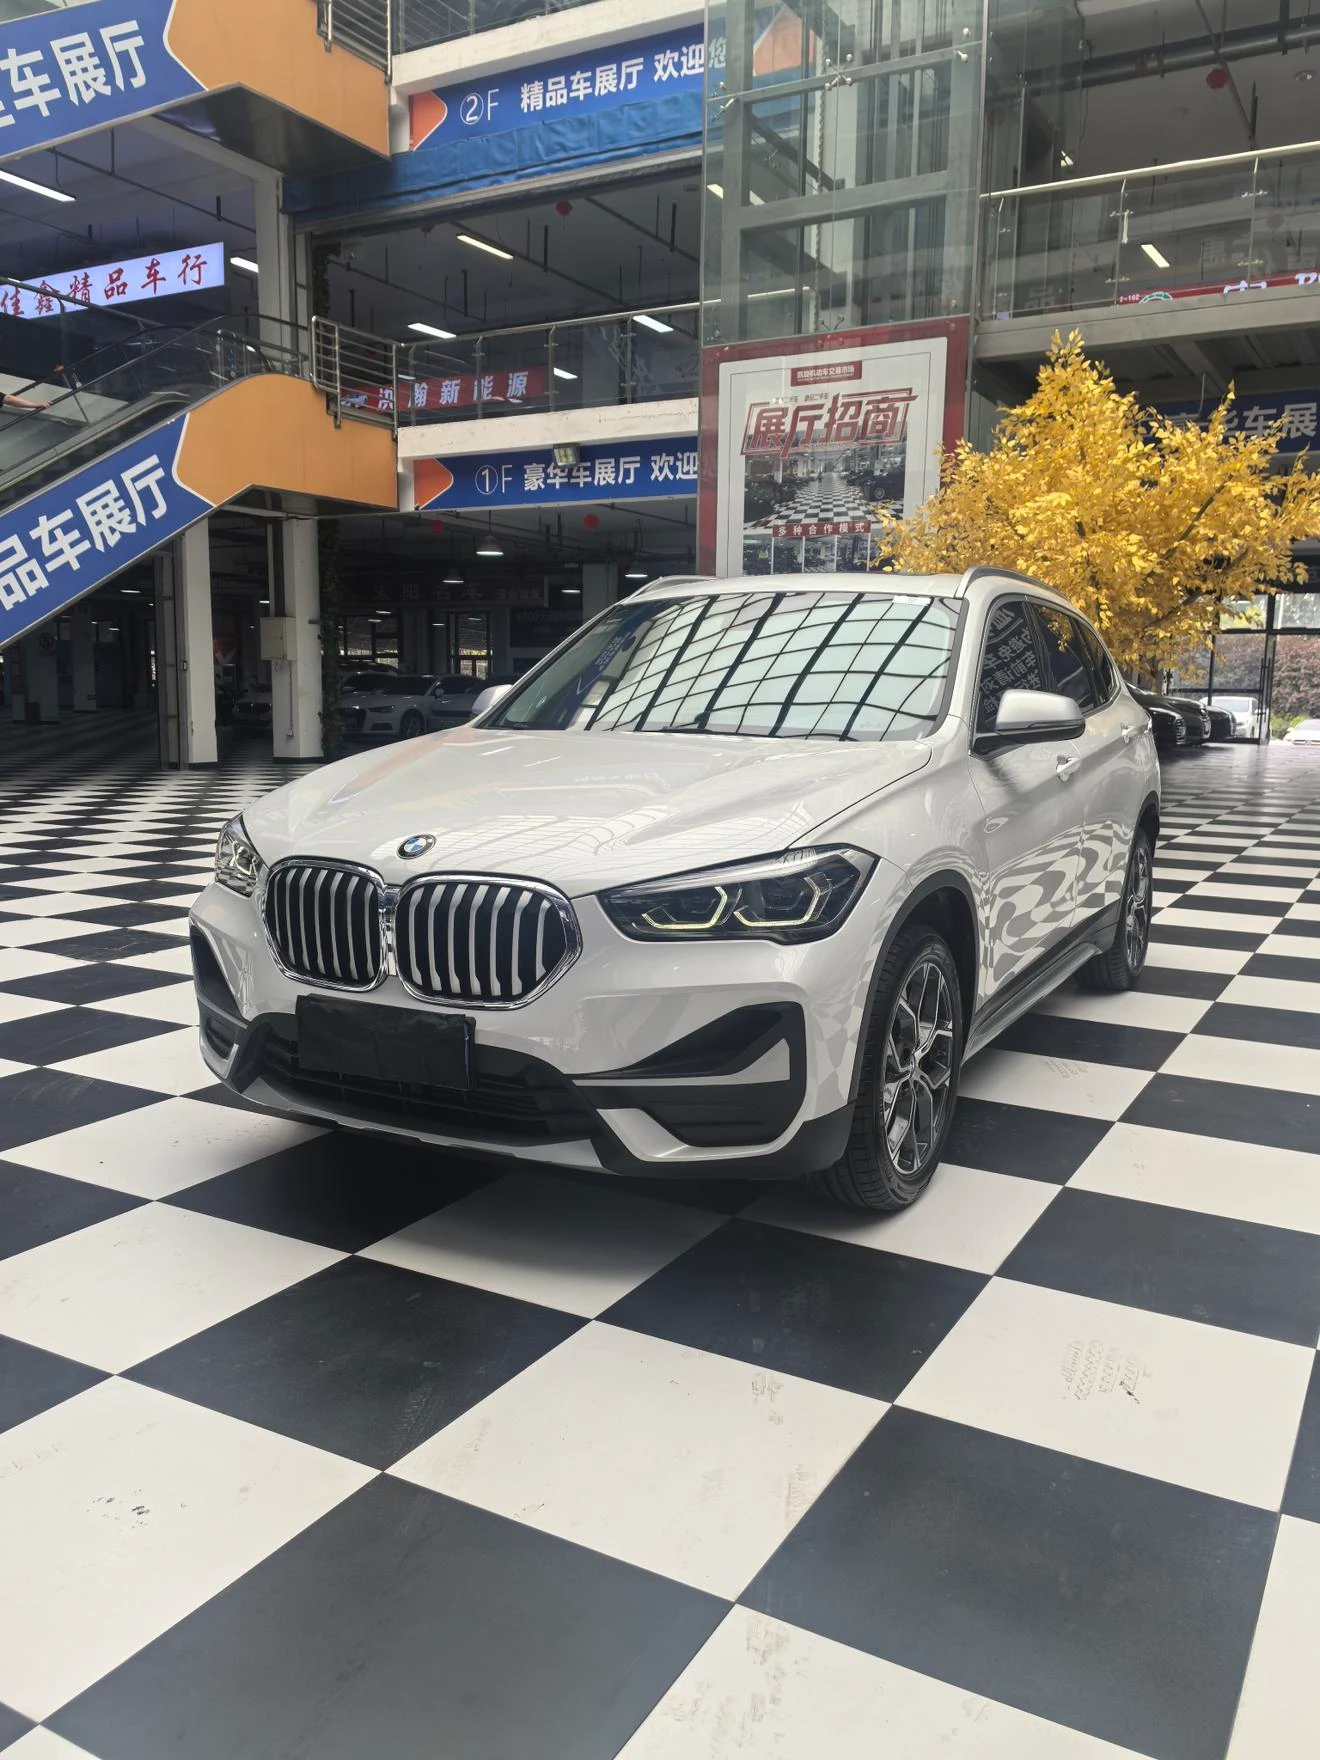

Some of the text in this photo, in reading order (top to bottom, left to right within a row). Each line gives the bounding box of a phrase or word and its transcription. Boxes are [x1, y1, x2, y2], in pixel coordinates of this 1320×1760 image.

[0, 20, 147, 128] 车展厅
[521, 57, 645, 113] 精品车展厅
[750, 393, 919, 458] 展厅招商
[523, 456, 641, 491] 豪华车展厅
[651, 450, 698, 481] 欢迎
[0, 454, 168, 611] 品车展厅
[778, 522, 865, 537] 多种合作模式
